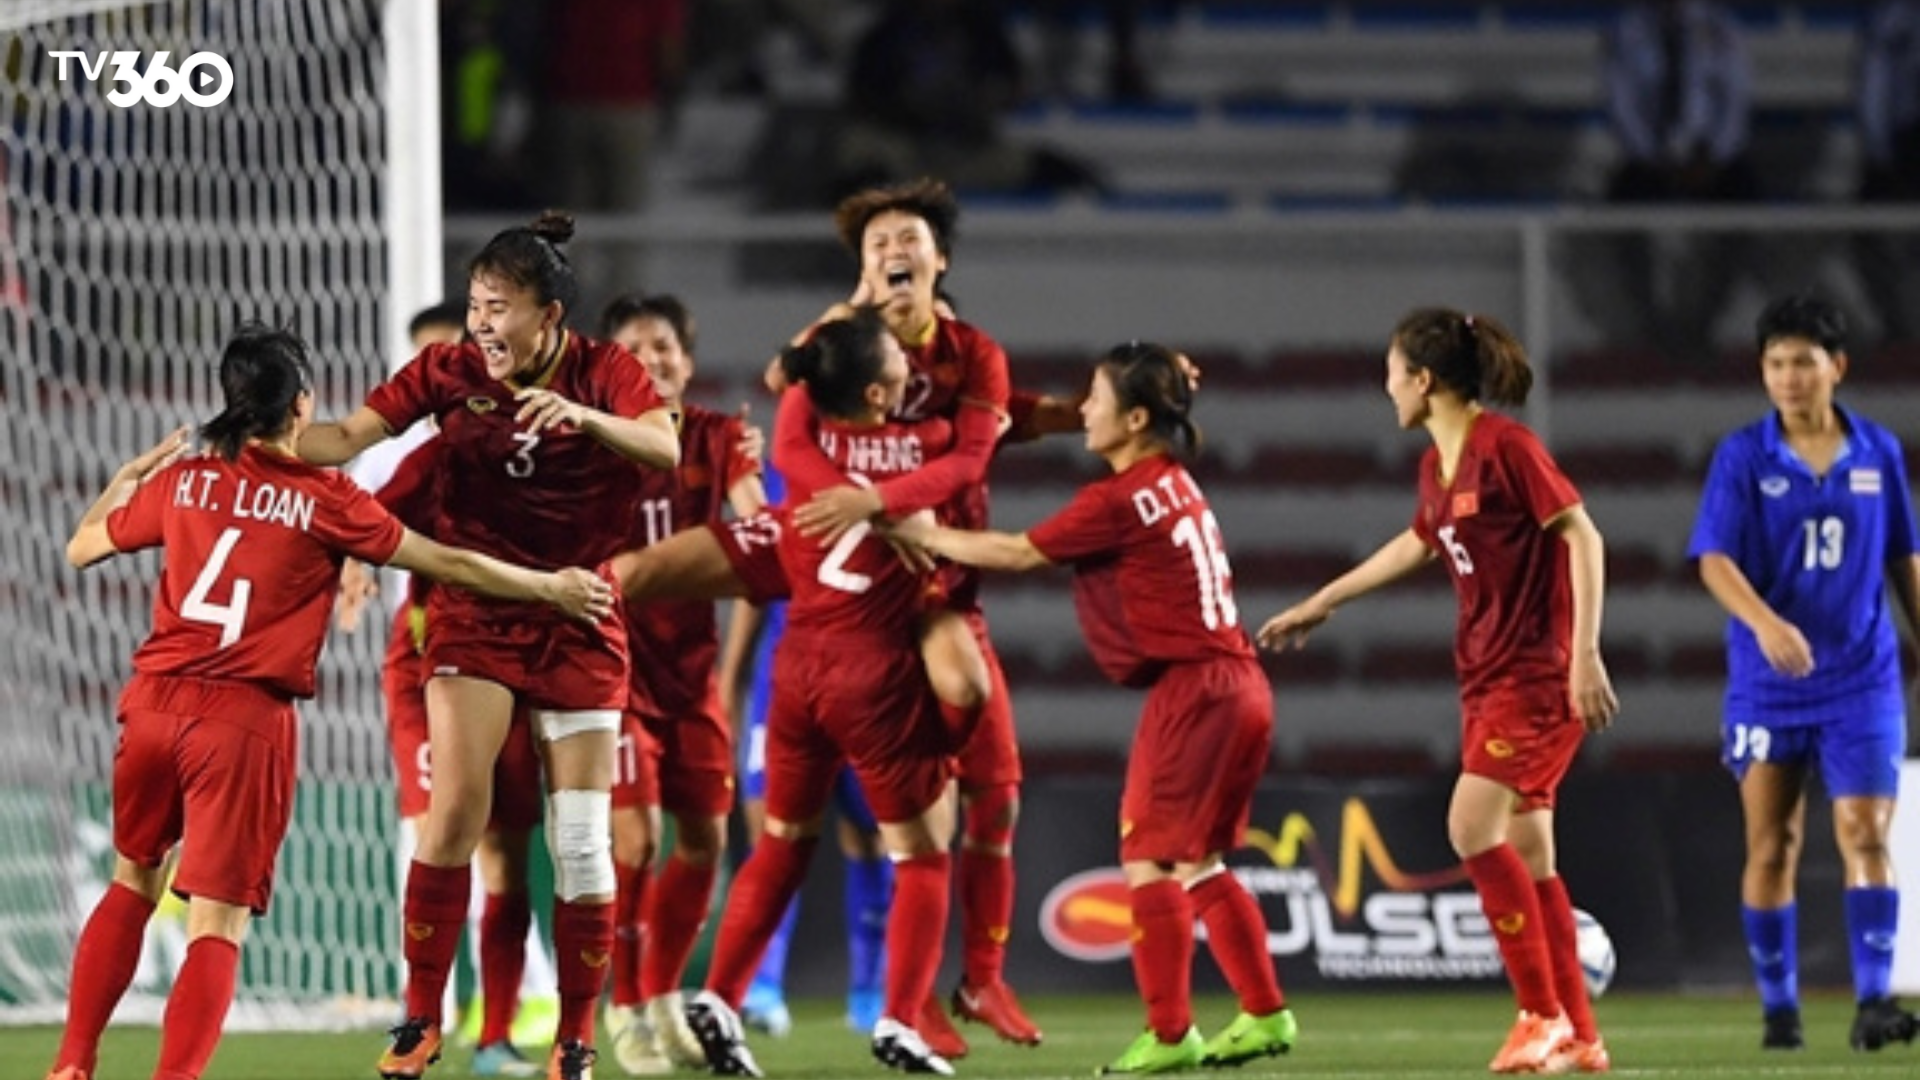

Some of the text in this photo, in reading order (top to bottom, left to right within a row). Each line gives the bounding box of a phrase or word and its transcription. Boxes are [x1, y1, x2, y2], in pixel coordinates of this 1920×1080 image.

[506, 433, 540, 477] 3
[847, 434, 922, 472] NHUNG
[233, 479, 315, 531] LOAN
[642, 498, 672, 546] 11
[817, 471, 873, 594] 2
[1803, 516, 1844, 570] 13
[180, 527, 250, 649] 4
[1194, 891, 1498, 955] ULSE
